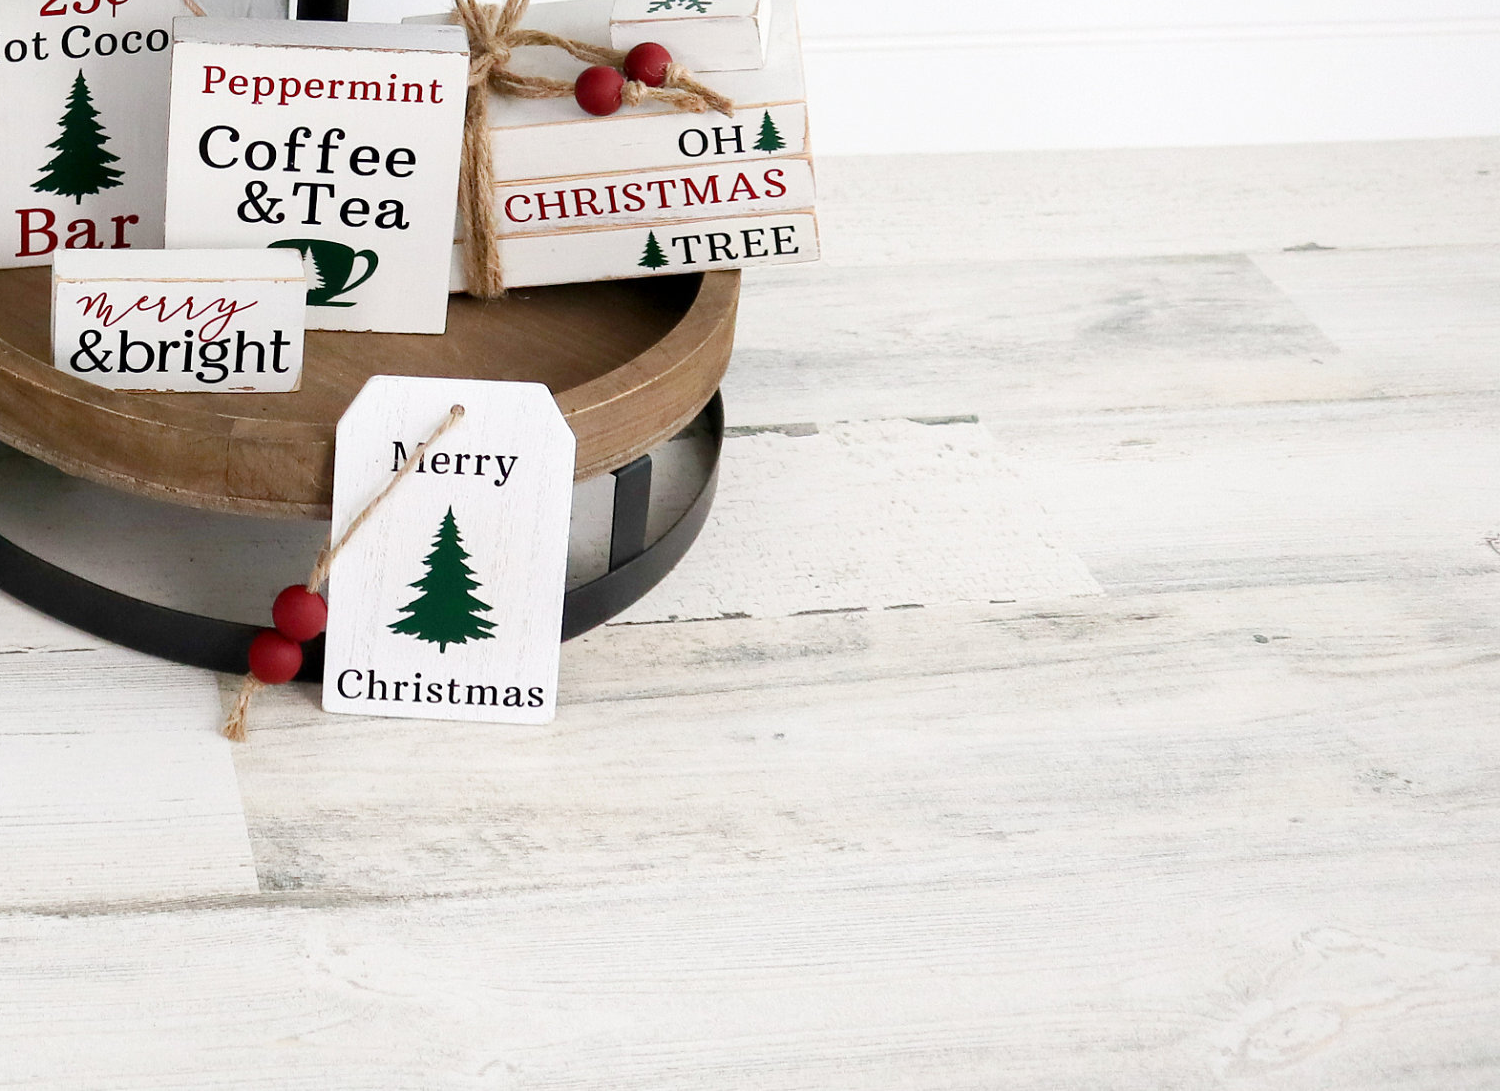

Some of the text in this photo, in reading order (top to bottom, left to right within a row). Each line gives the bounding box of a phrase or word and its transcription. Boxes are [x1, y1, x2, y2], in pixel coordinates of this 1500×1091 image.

[201, 65, 445, 106] Peppermint
[198, 124, 417, 178] Coffee
[677, 124, 747, 158] OH
[503, 168, 788, 224] CHRISTMAS
[15, 207, 140, 258] Bar
[670, 225, 801, 266] TREE
[75, 291, 259, 343] merry
[390, 440, 520, 488] Merry
[336, 668, 545, 708] Christmas
